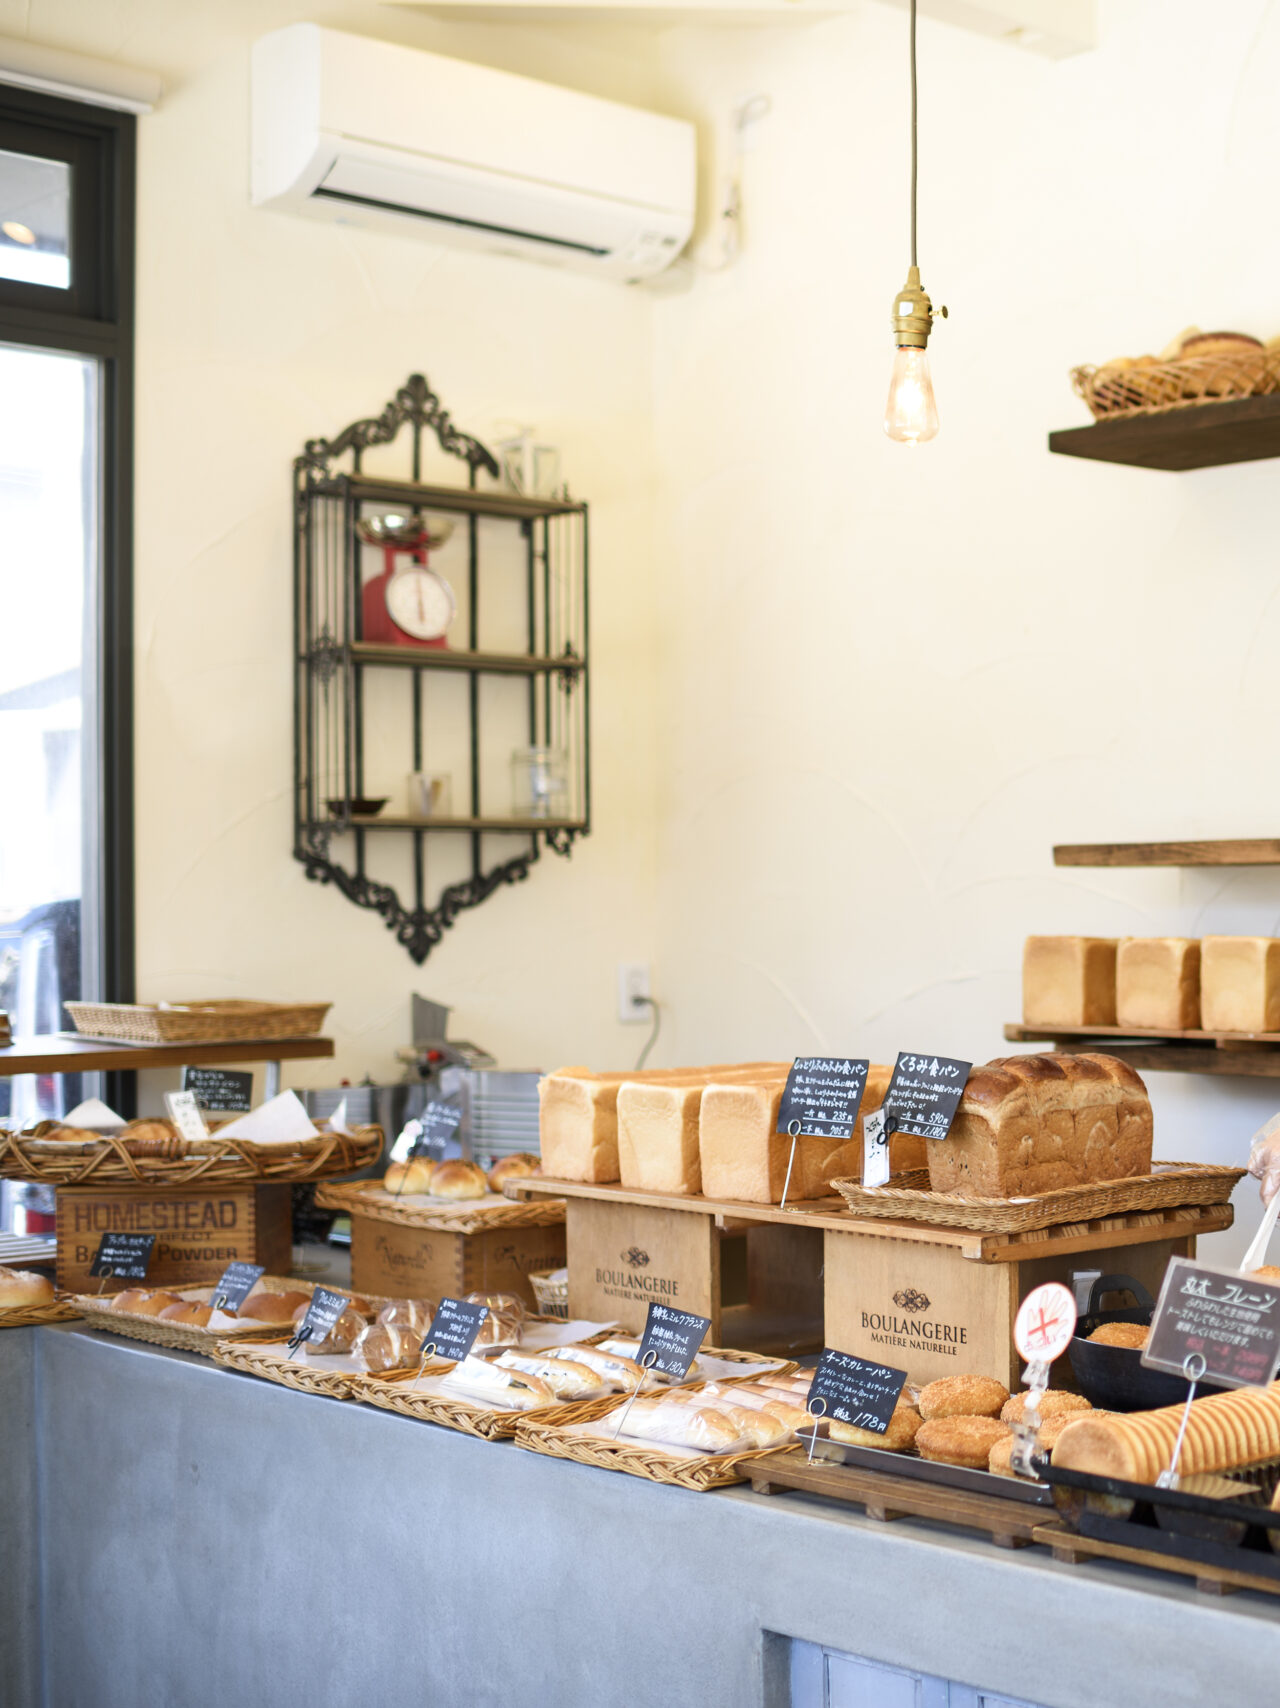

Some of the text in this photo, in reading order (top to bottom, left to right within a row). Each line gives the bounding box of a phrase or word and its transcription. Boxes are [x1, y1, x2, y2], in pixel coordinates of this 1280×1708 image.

[898, 1056, 960, 1078] くるみ食パン
[75, 1199, 238, 1232] HOMESTEAD
[157, 1243, 238, 1262] POWDER
[596, 1268, 679, 1296] BOULANGERIE
[861, 1311, 968, 1345] BOULANGERIE
[909, 1339, 958, 1356] NATURELLE
[665, 1360, 686, 1376] 130円
[826, 1351, 893, 1380] チーズカレーパン
[852, 1411, 887, 1431] 178円
